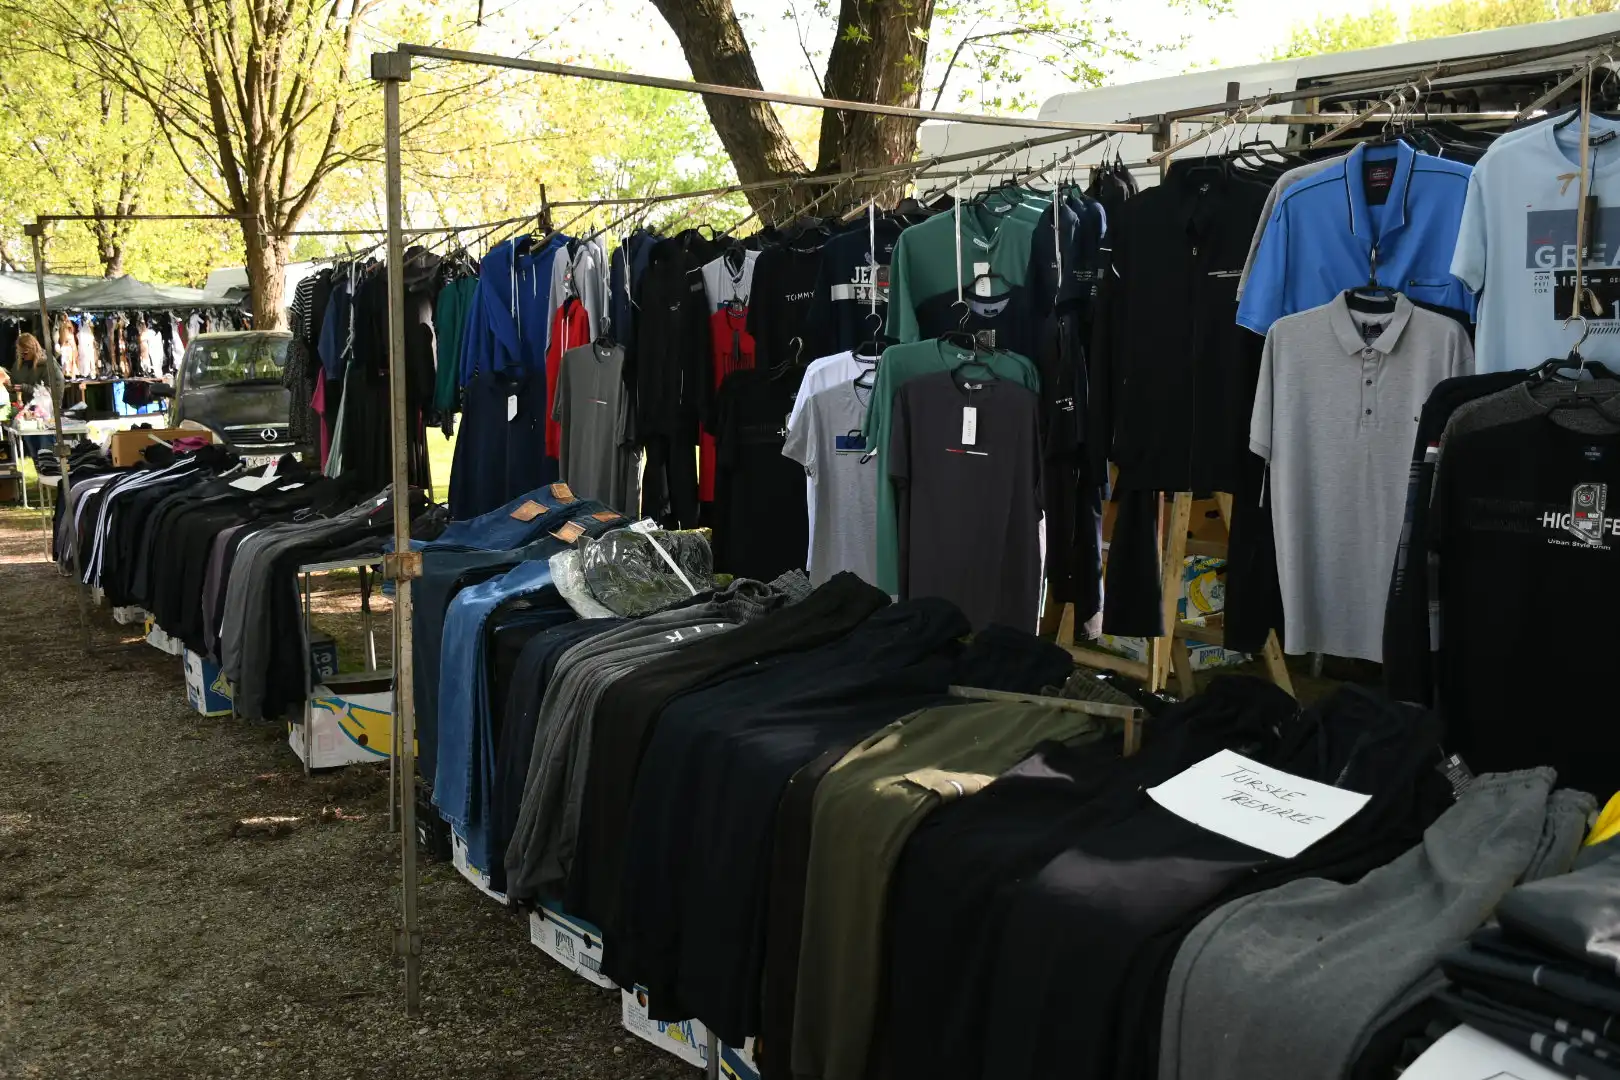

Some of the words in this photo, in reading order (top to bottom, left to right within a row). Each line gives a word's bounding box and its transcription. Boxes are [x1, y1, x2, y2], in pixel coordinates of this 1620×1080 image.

[785, 290, 816, 302] TOMMY
[1547, 538, 1570, 547] Urban
[1572, 541, 1591, 549] Style
[1199, 648, 1225, 664] BONITA
[1221, 765, 1307, 802] TURSKE
[1221, 789, 1325, 825] TRENIRKE
